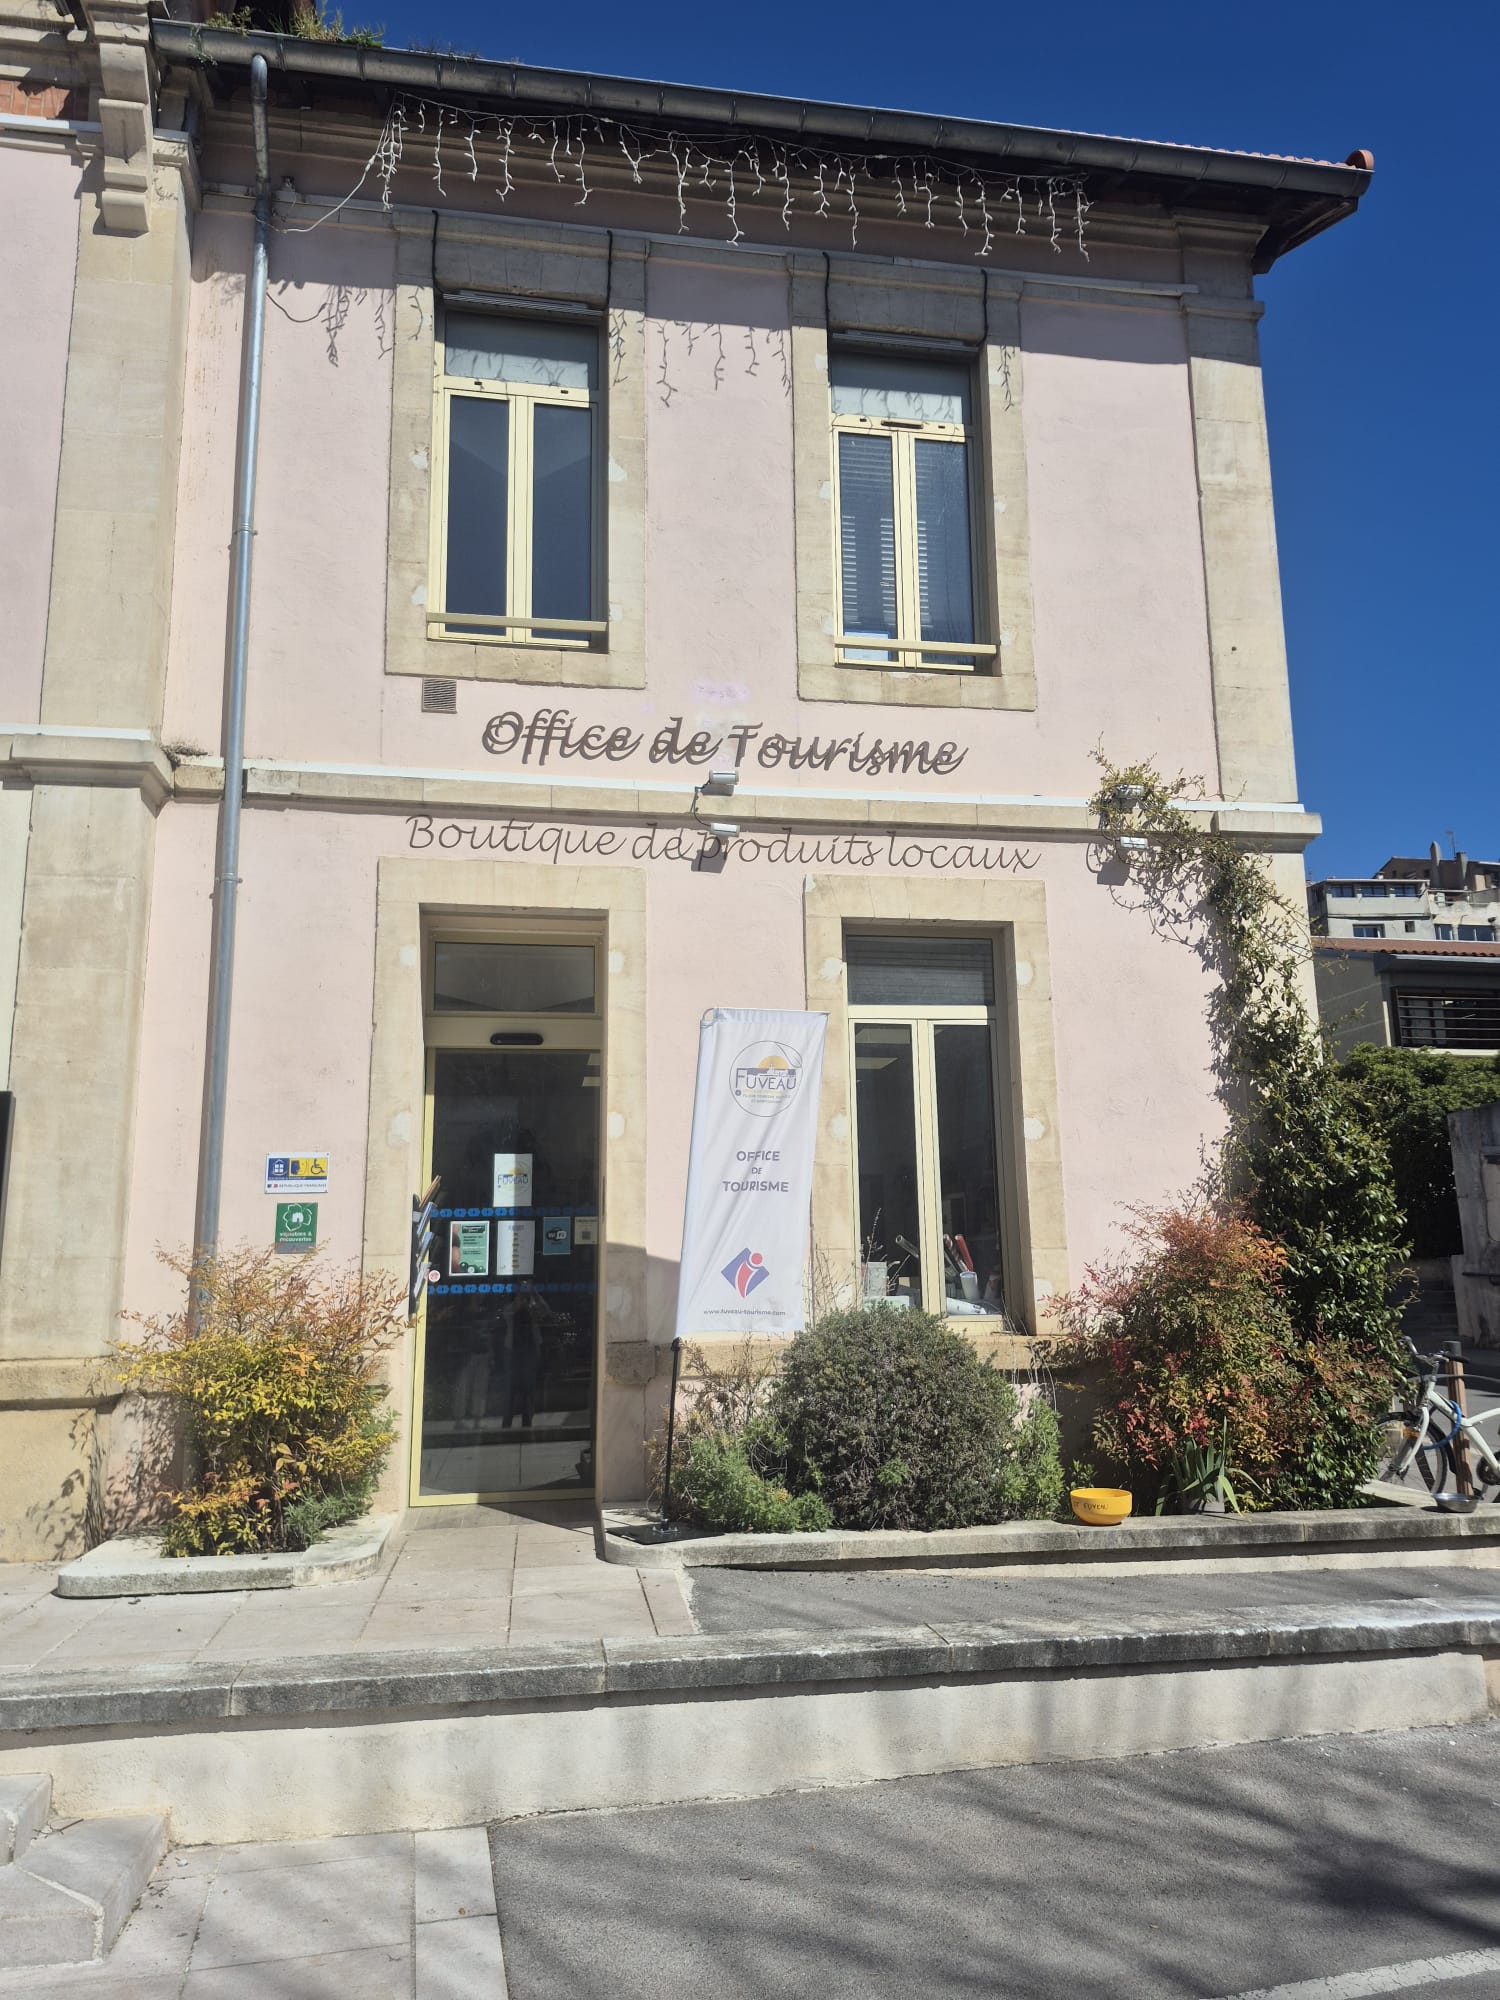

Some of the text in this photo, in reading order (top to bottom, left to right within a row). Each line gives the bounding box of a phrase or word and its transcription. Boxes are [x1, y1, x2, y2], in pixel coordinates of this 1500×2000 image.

[483, 708, 969, 776] Office de Tourisme
[405, 814, 1042, 873] Boutique de produits locaux
[735, 1067, 797, 1090] FUVEAU
[736, 1150, 781, 1162] OFFICE
[751, 1167, 763, 1175] DE
[722, 1180, 789, 1192] TOURISME
